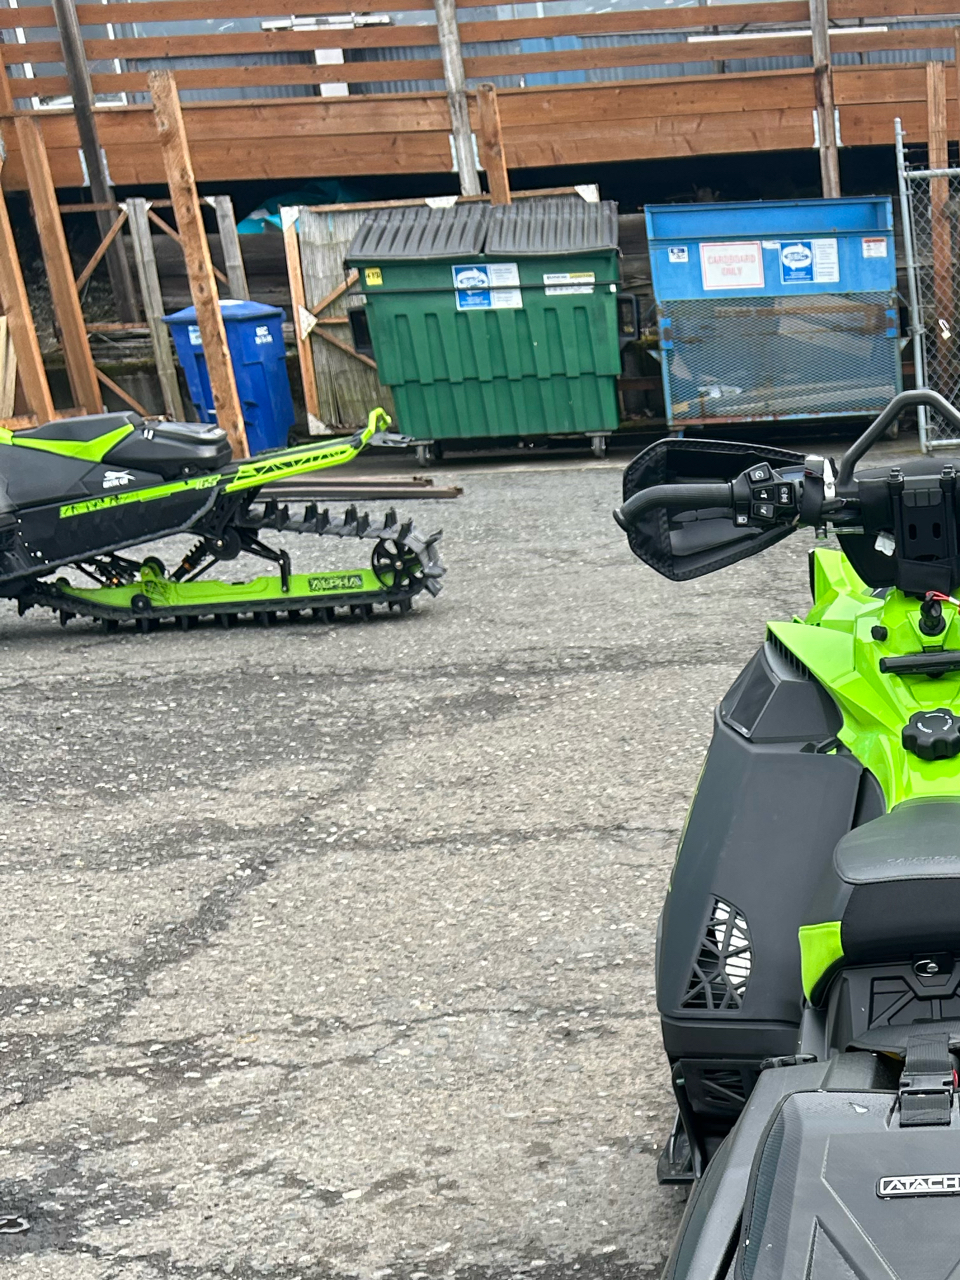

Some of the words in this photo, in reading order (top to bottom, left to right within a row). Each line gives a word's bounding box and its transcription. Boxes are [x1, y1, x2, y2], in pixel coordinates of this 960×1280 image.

[708, 253, 756, 264] CARDBOARD
[721, 267, 743, 277] ONLY
[310, 576, 362, 591] ALPHA
